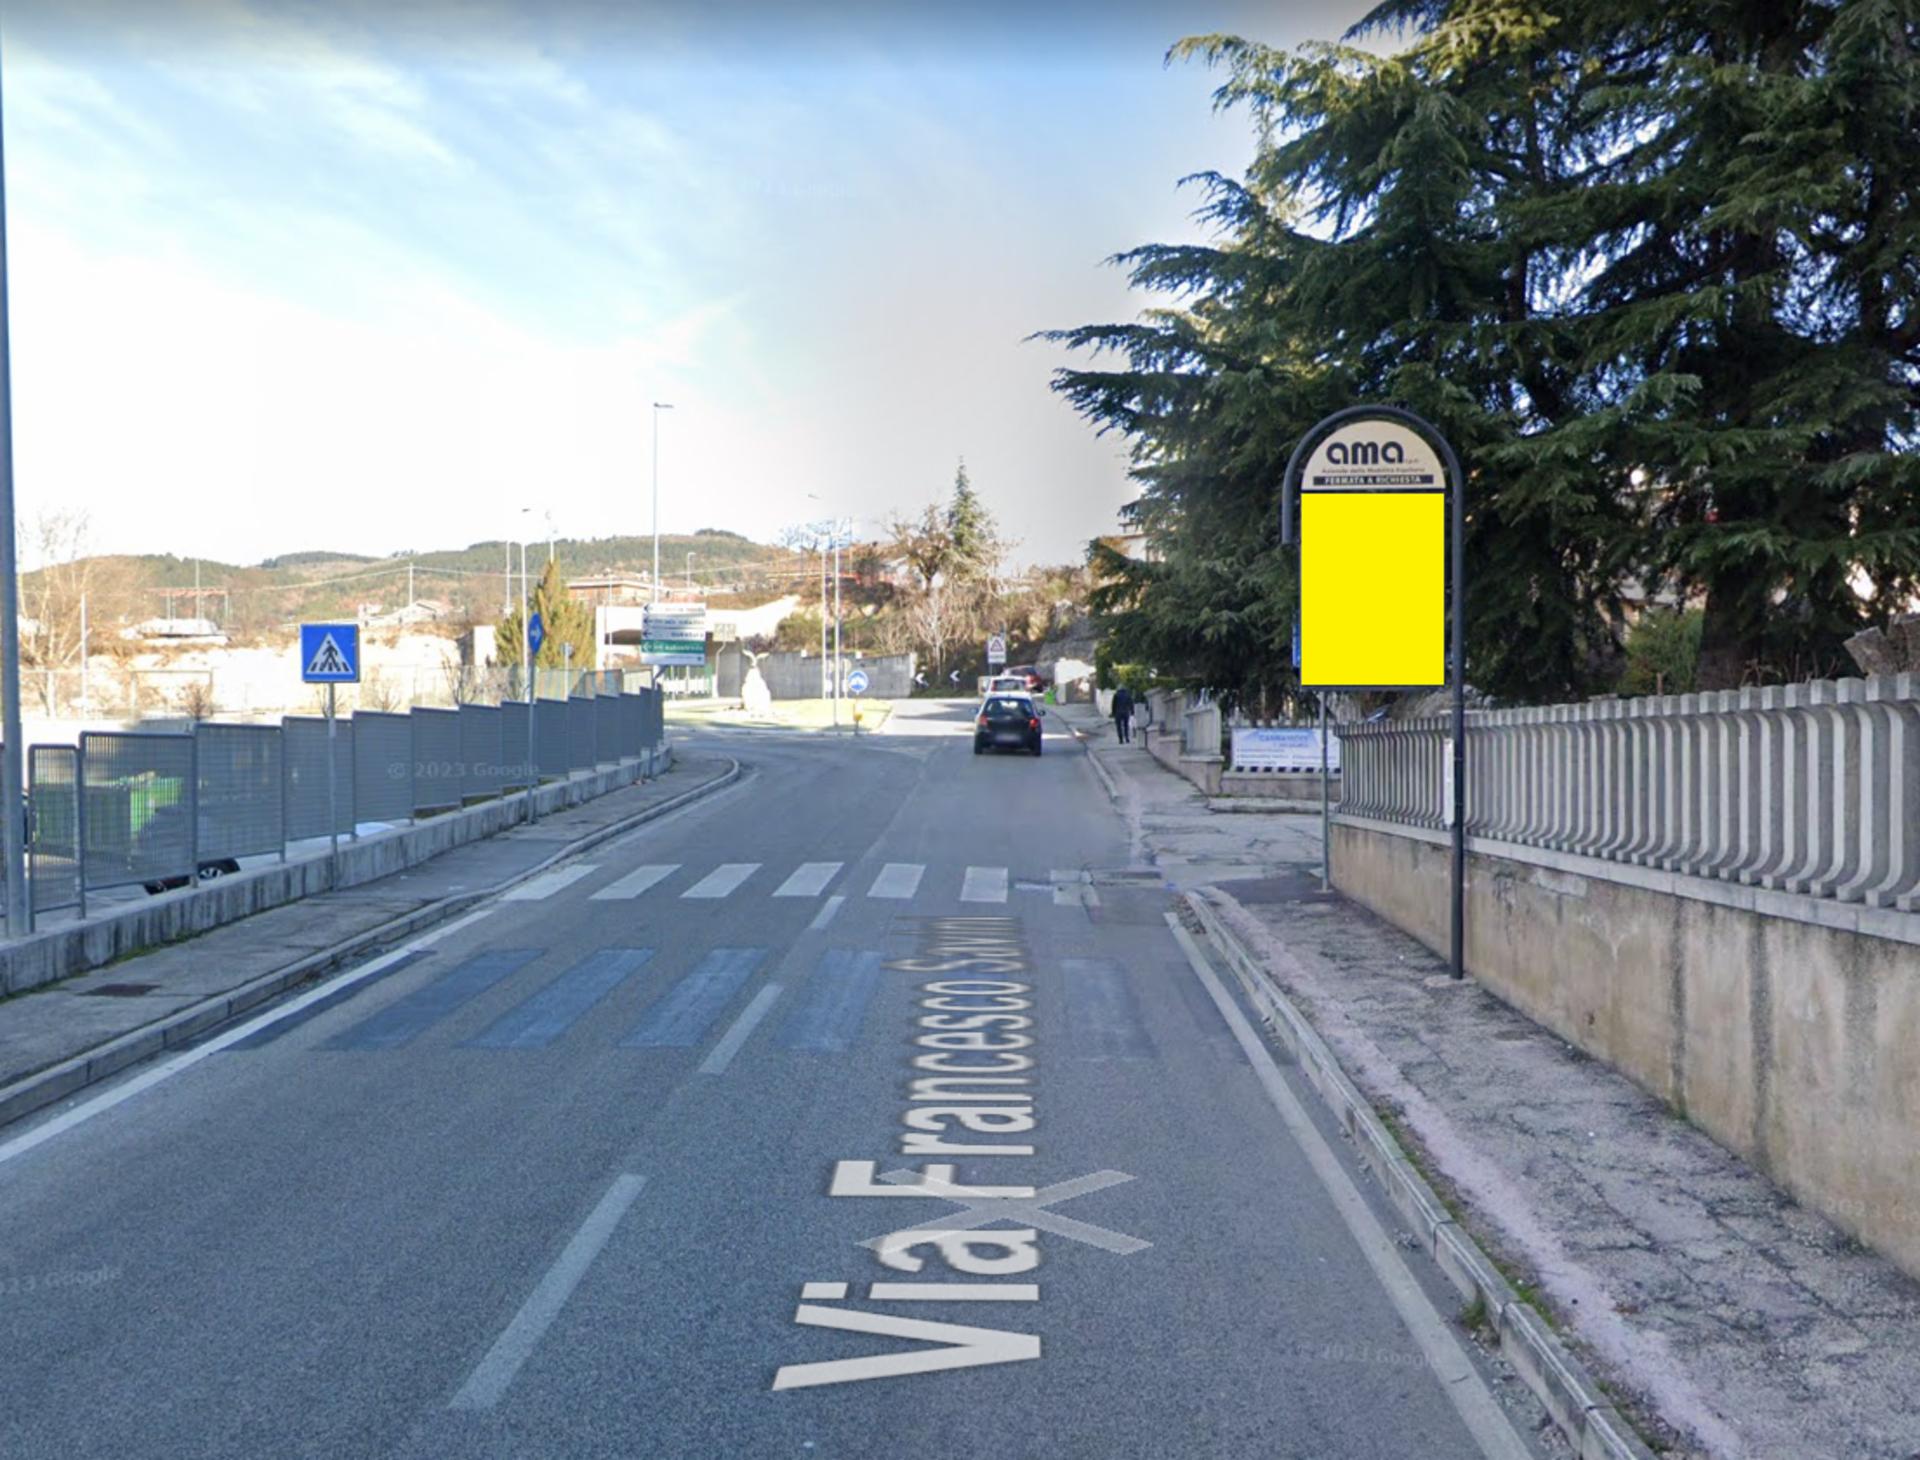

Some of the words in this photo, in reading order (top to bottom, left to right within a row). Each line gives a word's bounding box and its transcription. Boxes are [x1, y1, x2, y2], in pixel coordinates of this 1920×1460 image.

[1326, 441, 1404, 465] ama
[1324, 476, 1365, 485] FERMATA
[1375, 475, 1422, 484] RICHIESTA
